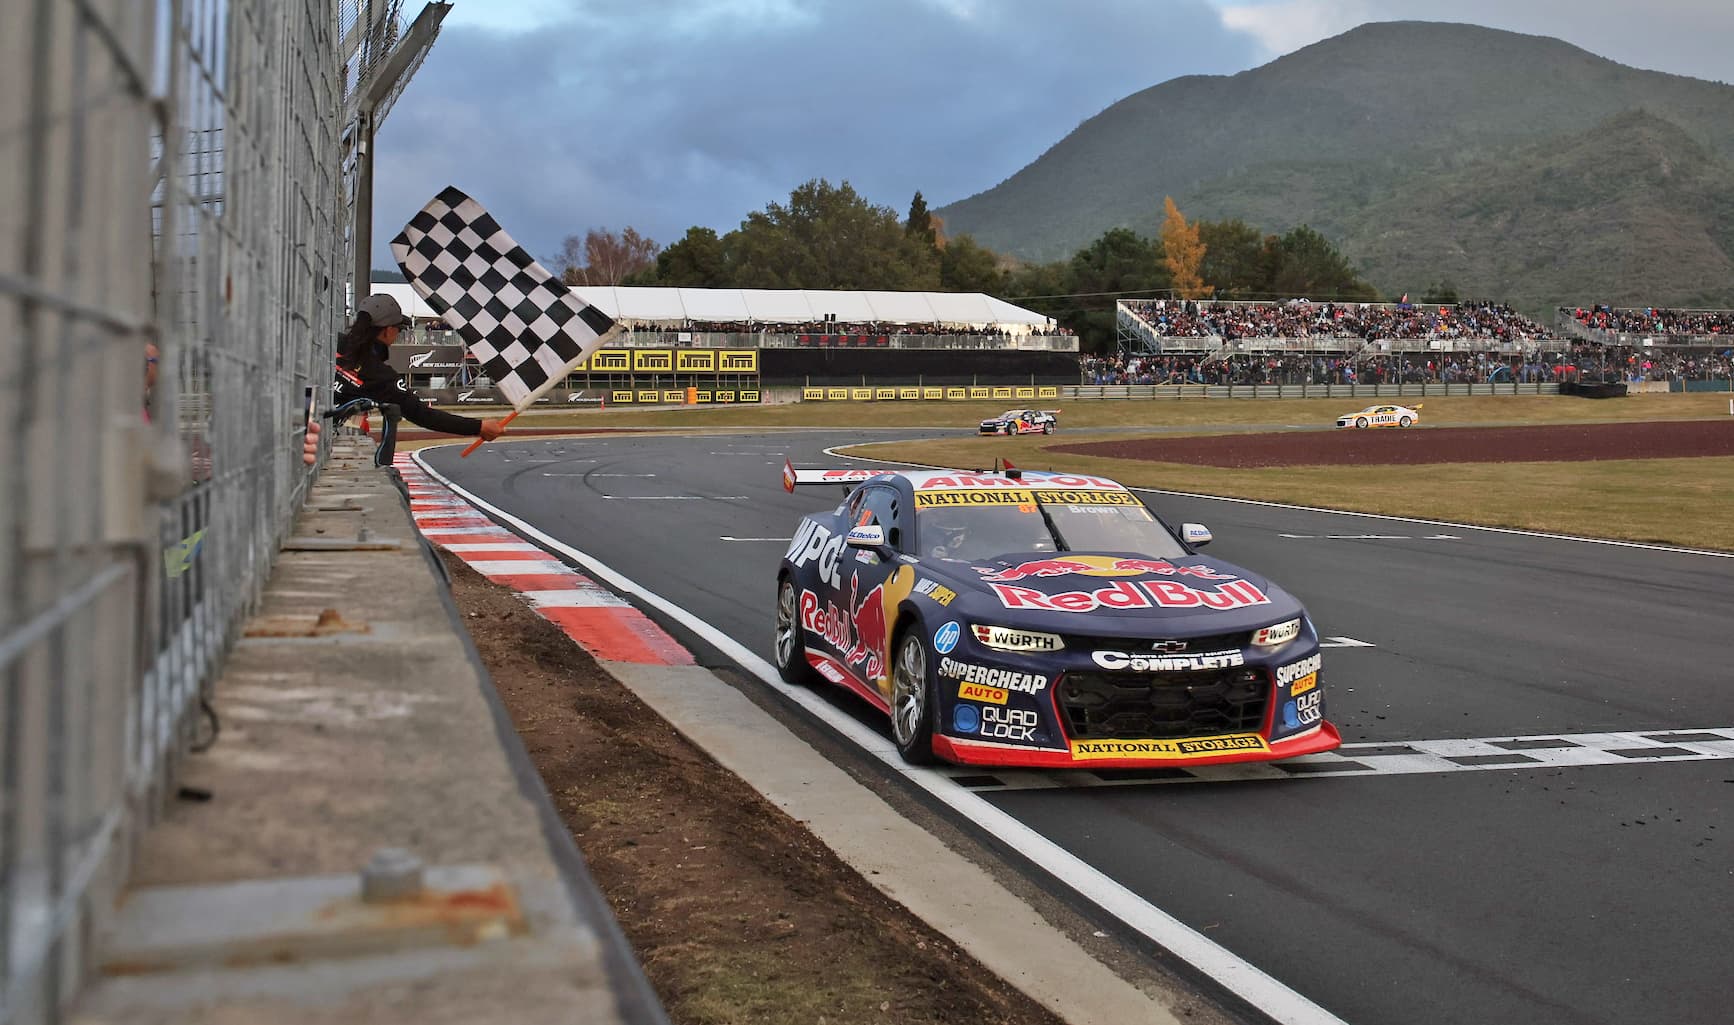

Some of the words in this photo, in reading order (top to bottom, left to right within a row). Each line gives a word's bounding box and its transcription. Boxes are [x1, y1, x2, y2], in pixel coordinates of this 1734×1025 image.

[1370, 415, 1395, 423] TRADIE
[919, 490, 1029, 506] NATIONAL
[1037, 491, 1134, 505] STORAGE
[1067, 504, 1119, 514] Brown
[986, 580, 1154, 612] Red
[1139, 578, 1272, 611] Bull
[936, 622, 958, 653] hp
[1091, 650, 1244, 671] COMPLETE
[938, 657, 1047, 695] SUPERCHEAP
[1294, 676, 1313, 690] AUTO
[964, 686, 1003, 699] AUTO
[982, 706, 1037, 727] QUAD
[980, 721, 1037, 741] LOCK
[1077, 743, 1176, 754] NATIONAL
[1184, 736, 1260, 752] STORAGE
